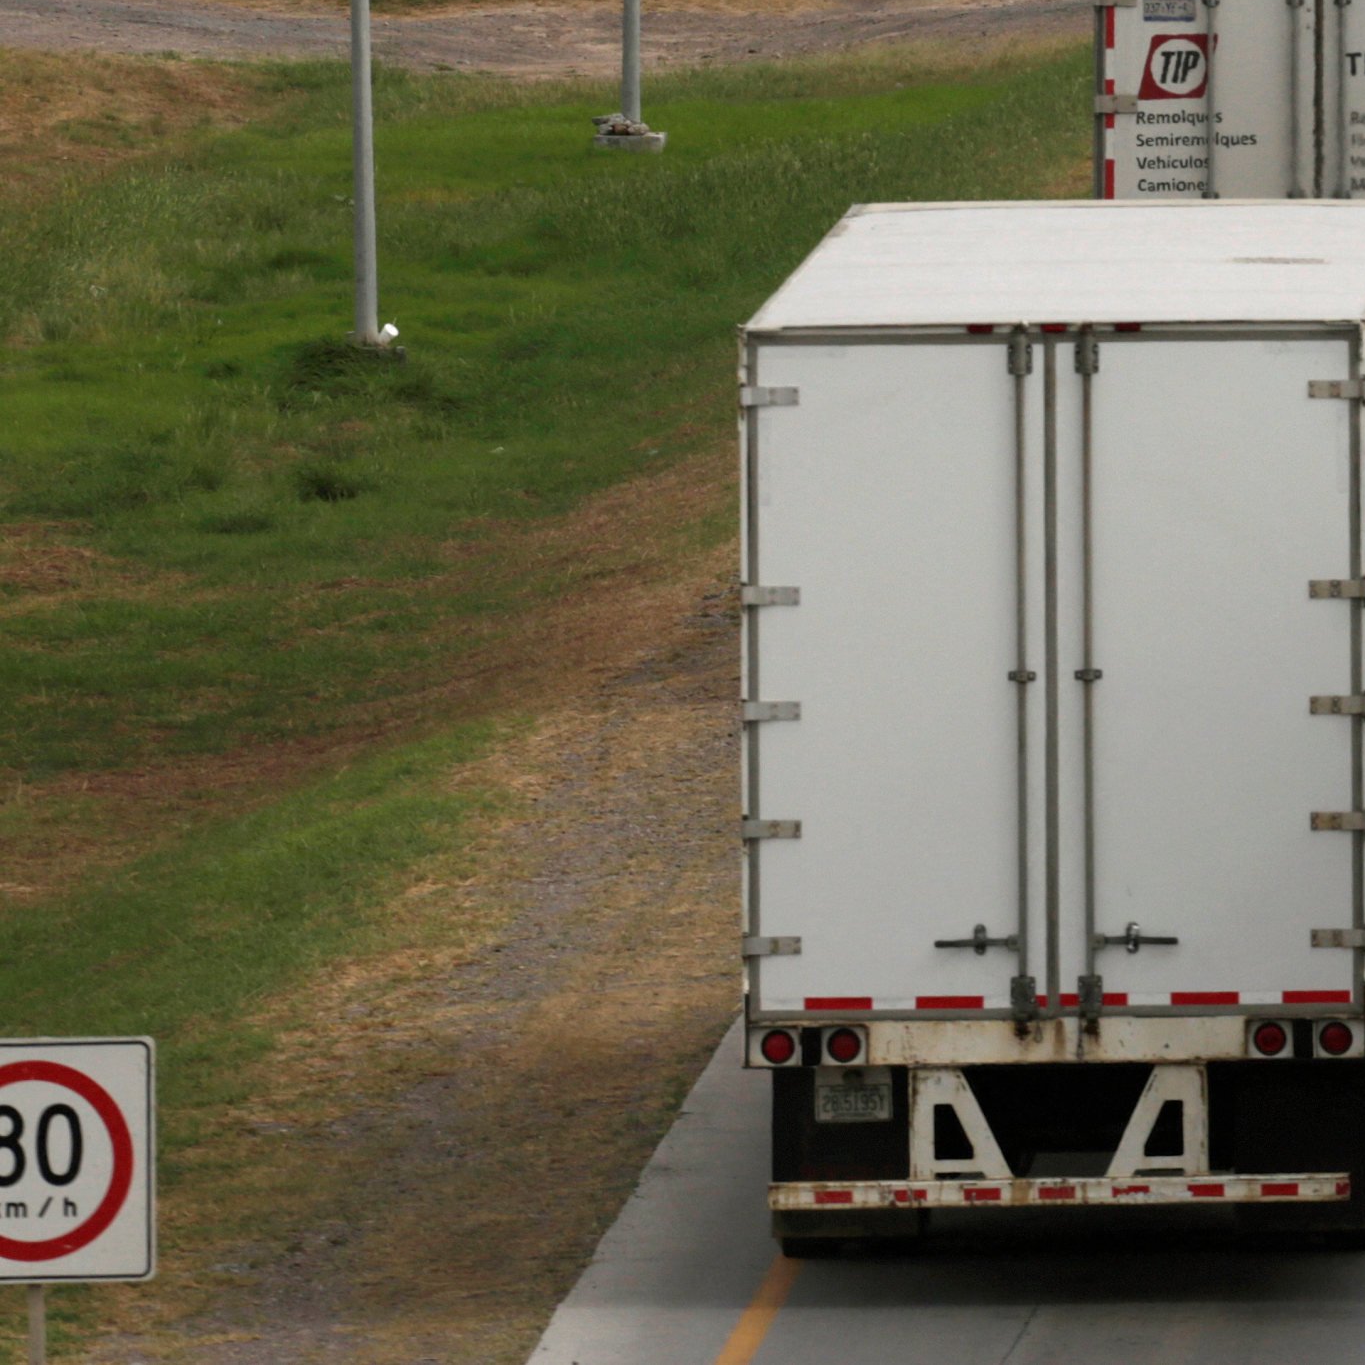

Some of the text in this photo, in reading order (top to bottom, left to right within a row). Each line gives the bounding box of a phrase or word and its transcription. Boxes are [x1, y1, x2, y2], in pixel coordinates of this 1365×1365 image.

[1160, 50, 1200, 84] TIP
[1136, 110, 1223, 125] Remolqus
[1136, 133, 1258, 148] Semiremlques
[1137, 178, 1209, 192] Camione
[0, 1102, 84, 1189] 80
[0, 1195, 78, 1218] m/h
